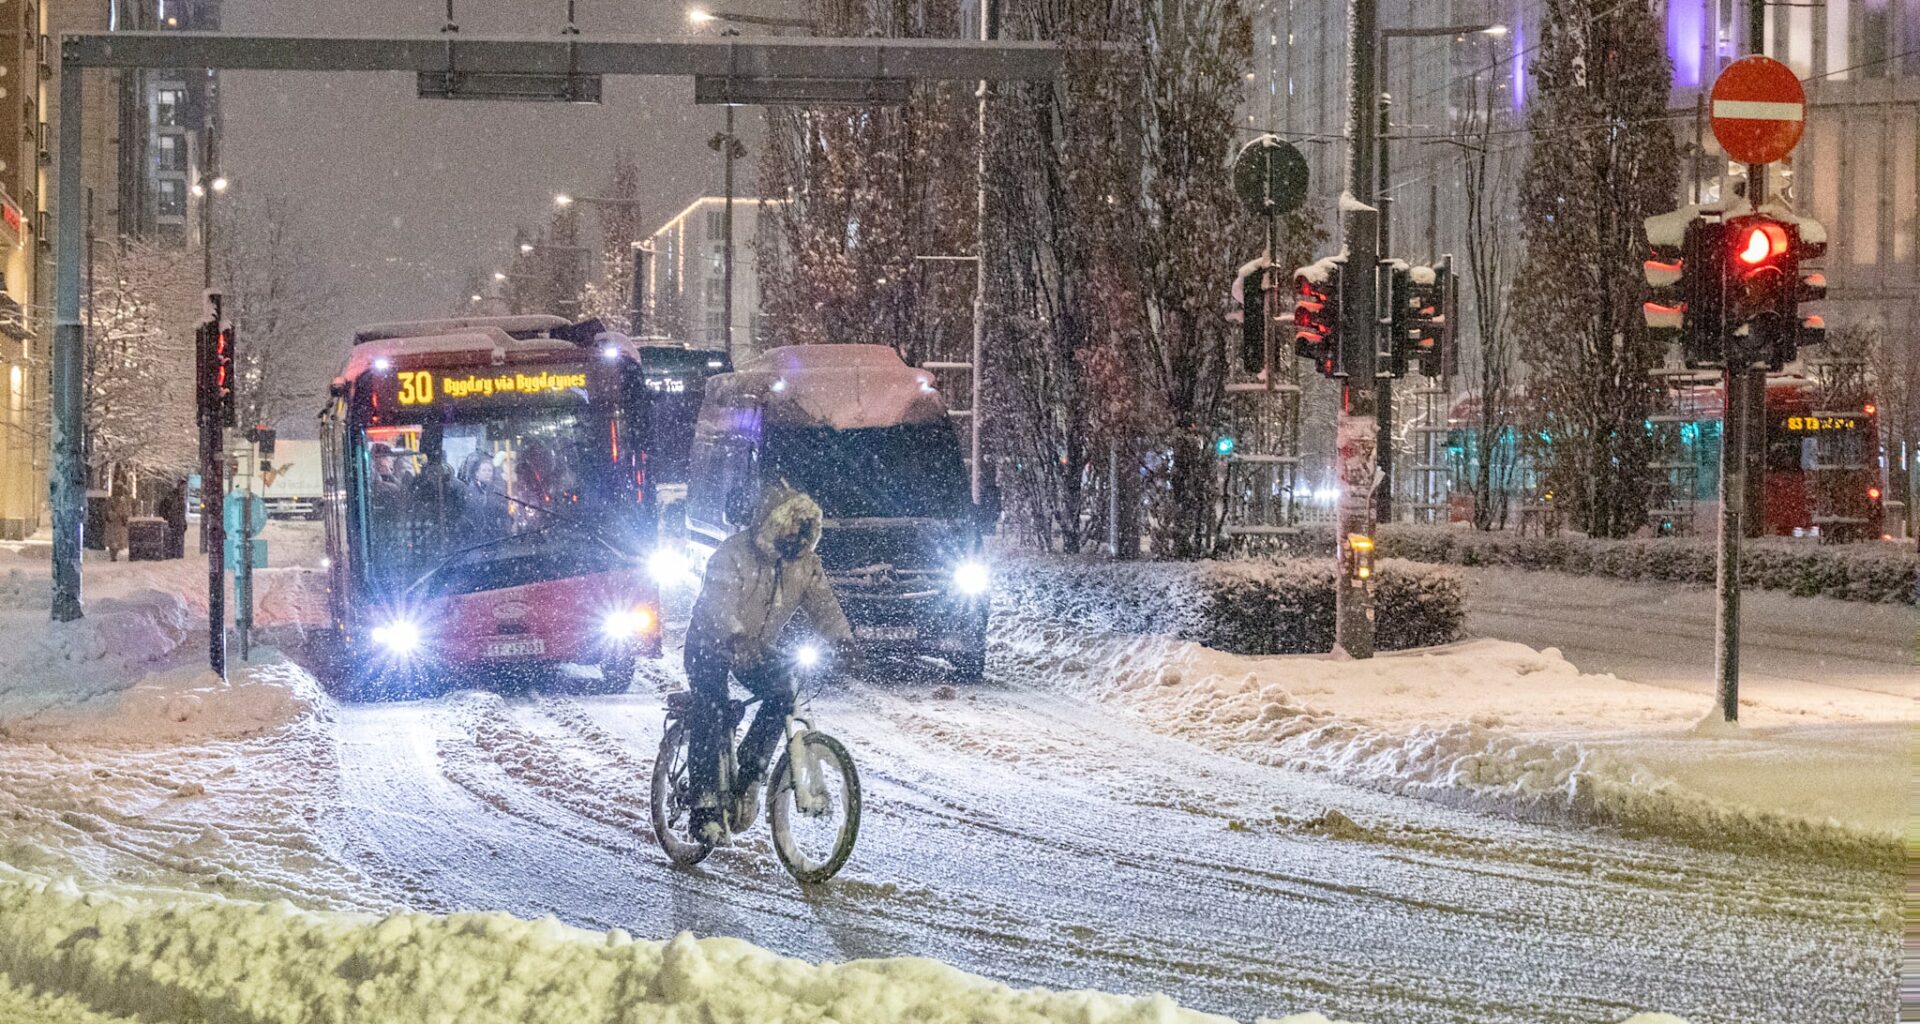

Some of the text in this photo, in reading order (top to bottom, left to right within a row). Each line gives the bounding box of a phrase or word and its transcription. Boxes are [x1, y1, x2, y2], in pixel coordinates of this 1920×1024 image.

[398, 370, 587, 405] 30 Bygdøy via Bygdøynes
